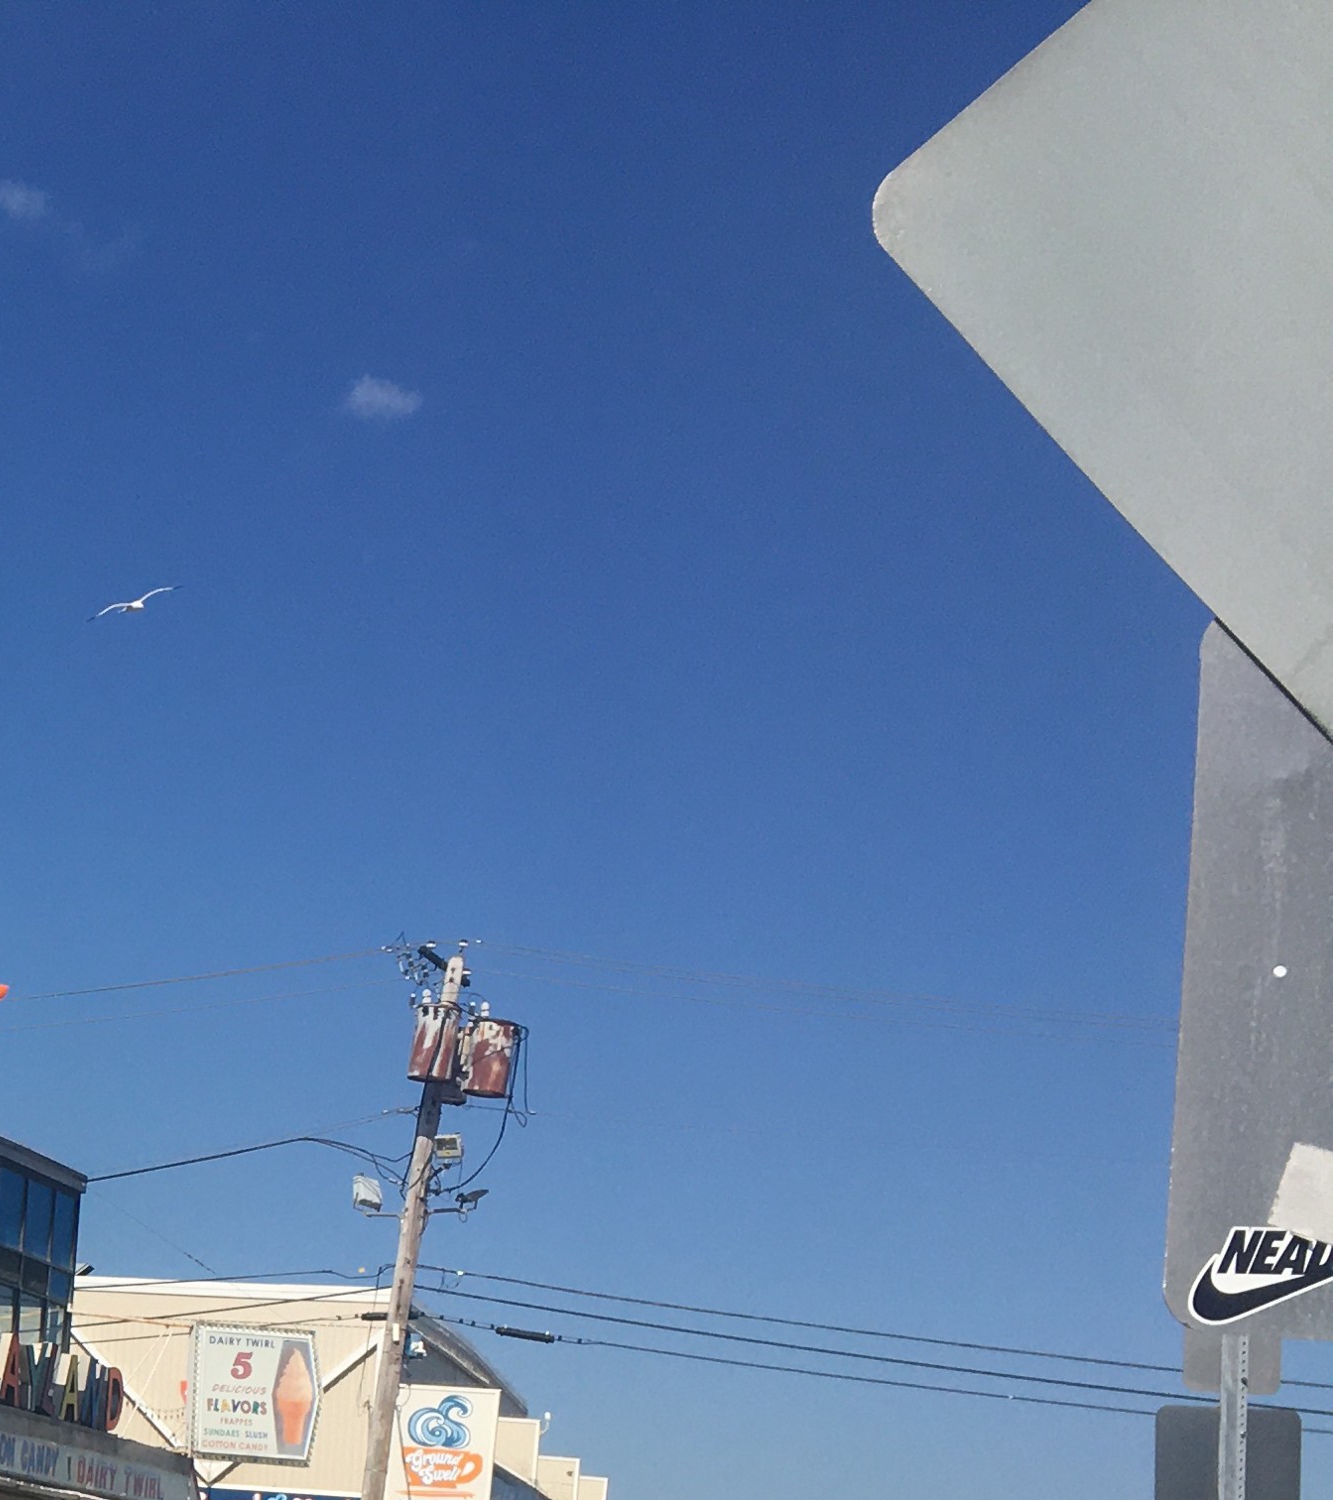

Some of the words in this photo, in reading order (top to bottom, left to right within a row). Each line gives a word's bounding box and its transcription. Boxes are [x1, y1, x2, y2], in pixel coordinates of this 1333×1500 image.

[208, 1335, 242, 1346] DAIRY
[245, 1337, 276, 1349] TWIRL
[230, 1351, 253, 1380] 5
[211, 1383, 267, 1396] DELICIOUS
[206, 1397, 267, 1416] FLAVORS
[201, 1438, 237, 1450] COTTON
[20, 1439, 60, 1477] CANDY
[404, 1448, 464, 1472] Ground
[76, 1455, 118, 1491] DAIRY
[419, 1467, 462, 1486] Swell
